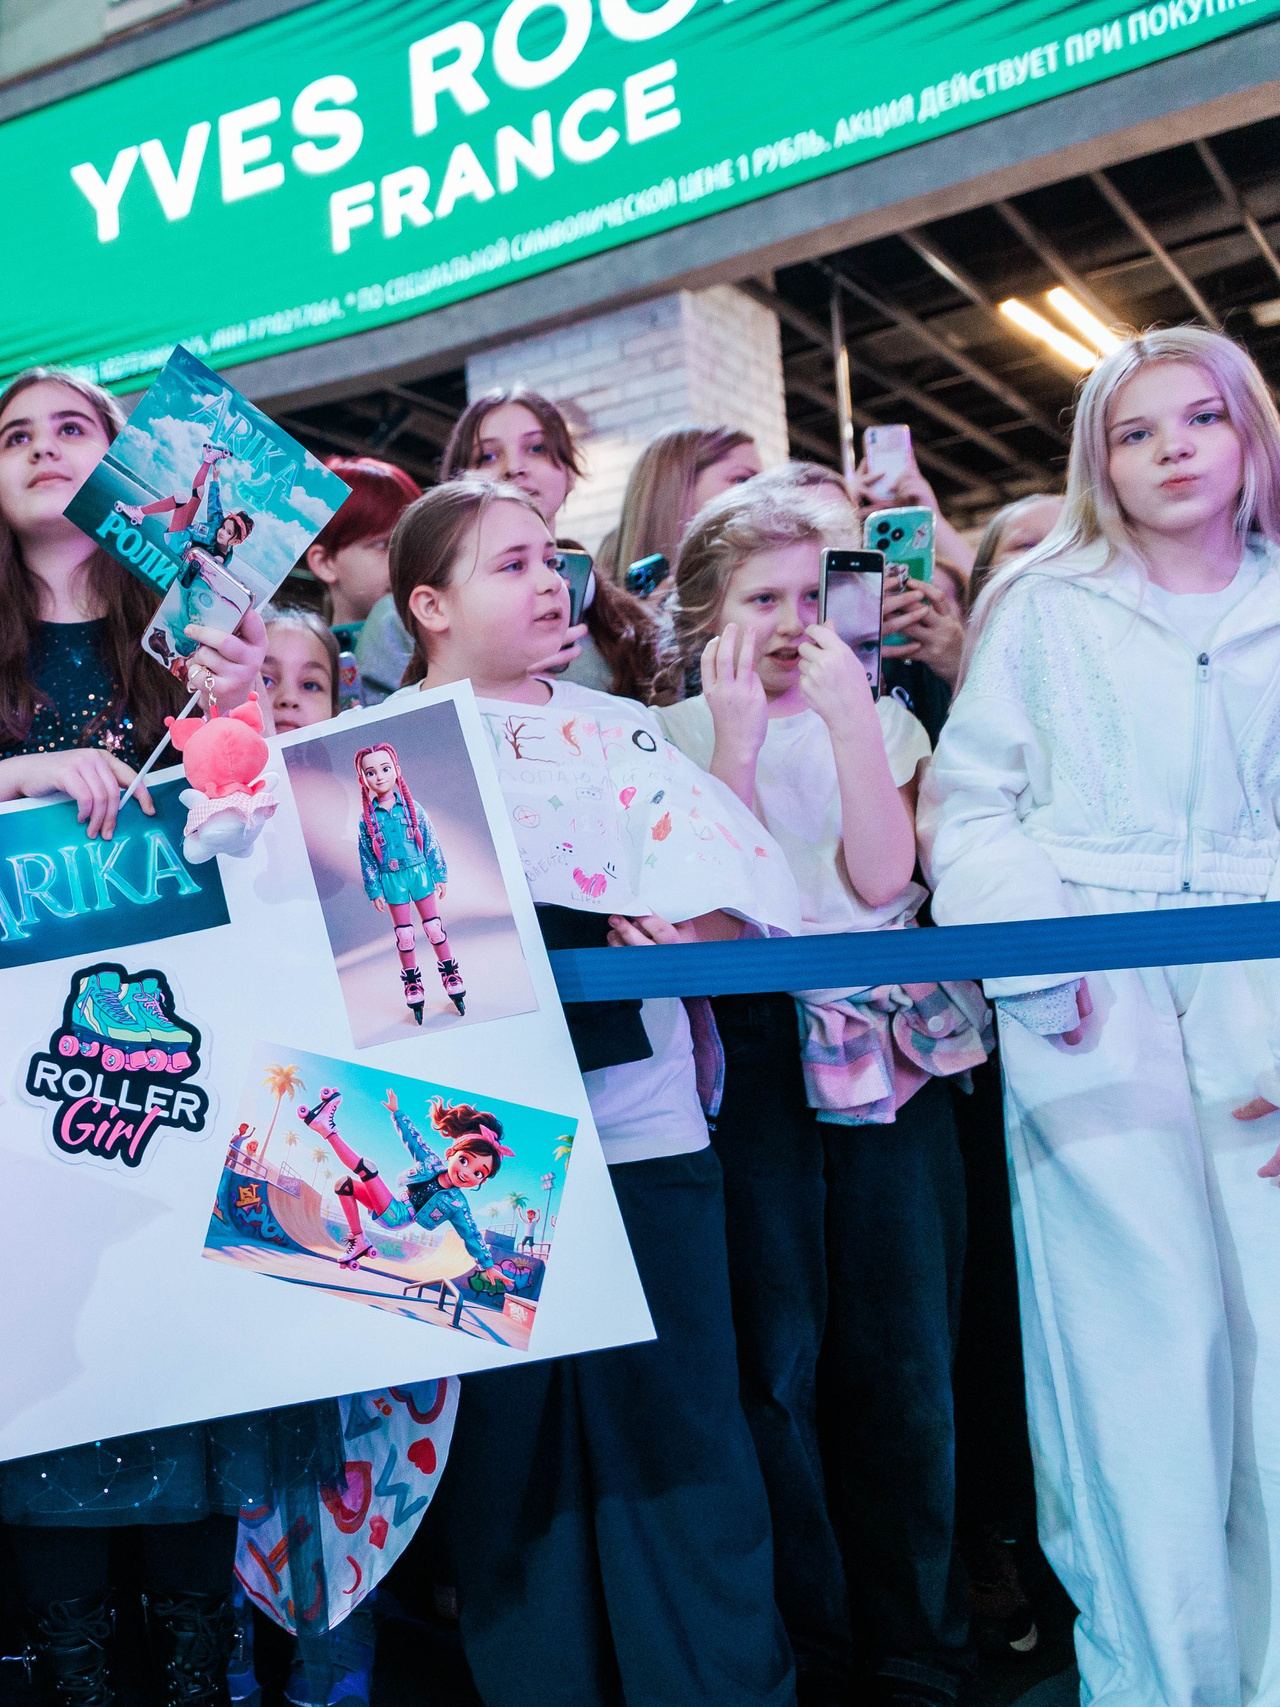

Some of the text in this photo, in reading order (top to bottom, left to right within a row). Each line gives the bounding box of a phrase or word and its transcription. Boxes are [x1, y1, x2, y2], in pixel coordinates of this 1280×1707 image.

[833, 93, 914, 149] АКЦИЯ
[917, 42, 1061, 124] ДЕЙСТВУЕТ
[1064, 19, 1124, 67] ПРИ
[70, 74, 365, 244] YVES
[329, 58, 682, 254] FRANCE
[188, 388, 301, 502] ARIKA
[33, 1060, 202, 1124] ROLLER
[60, 1096, 163, 1159] Girl
